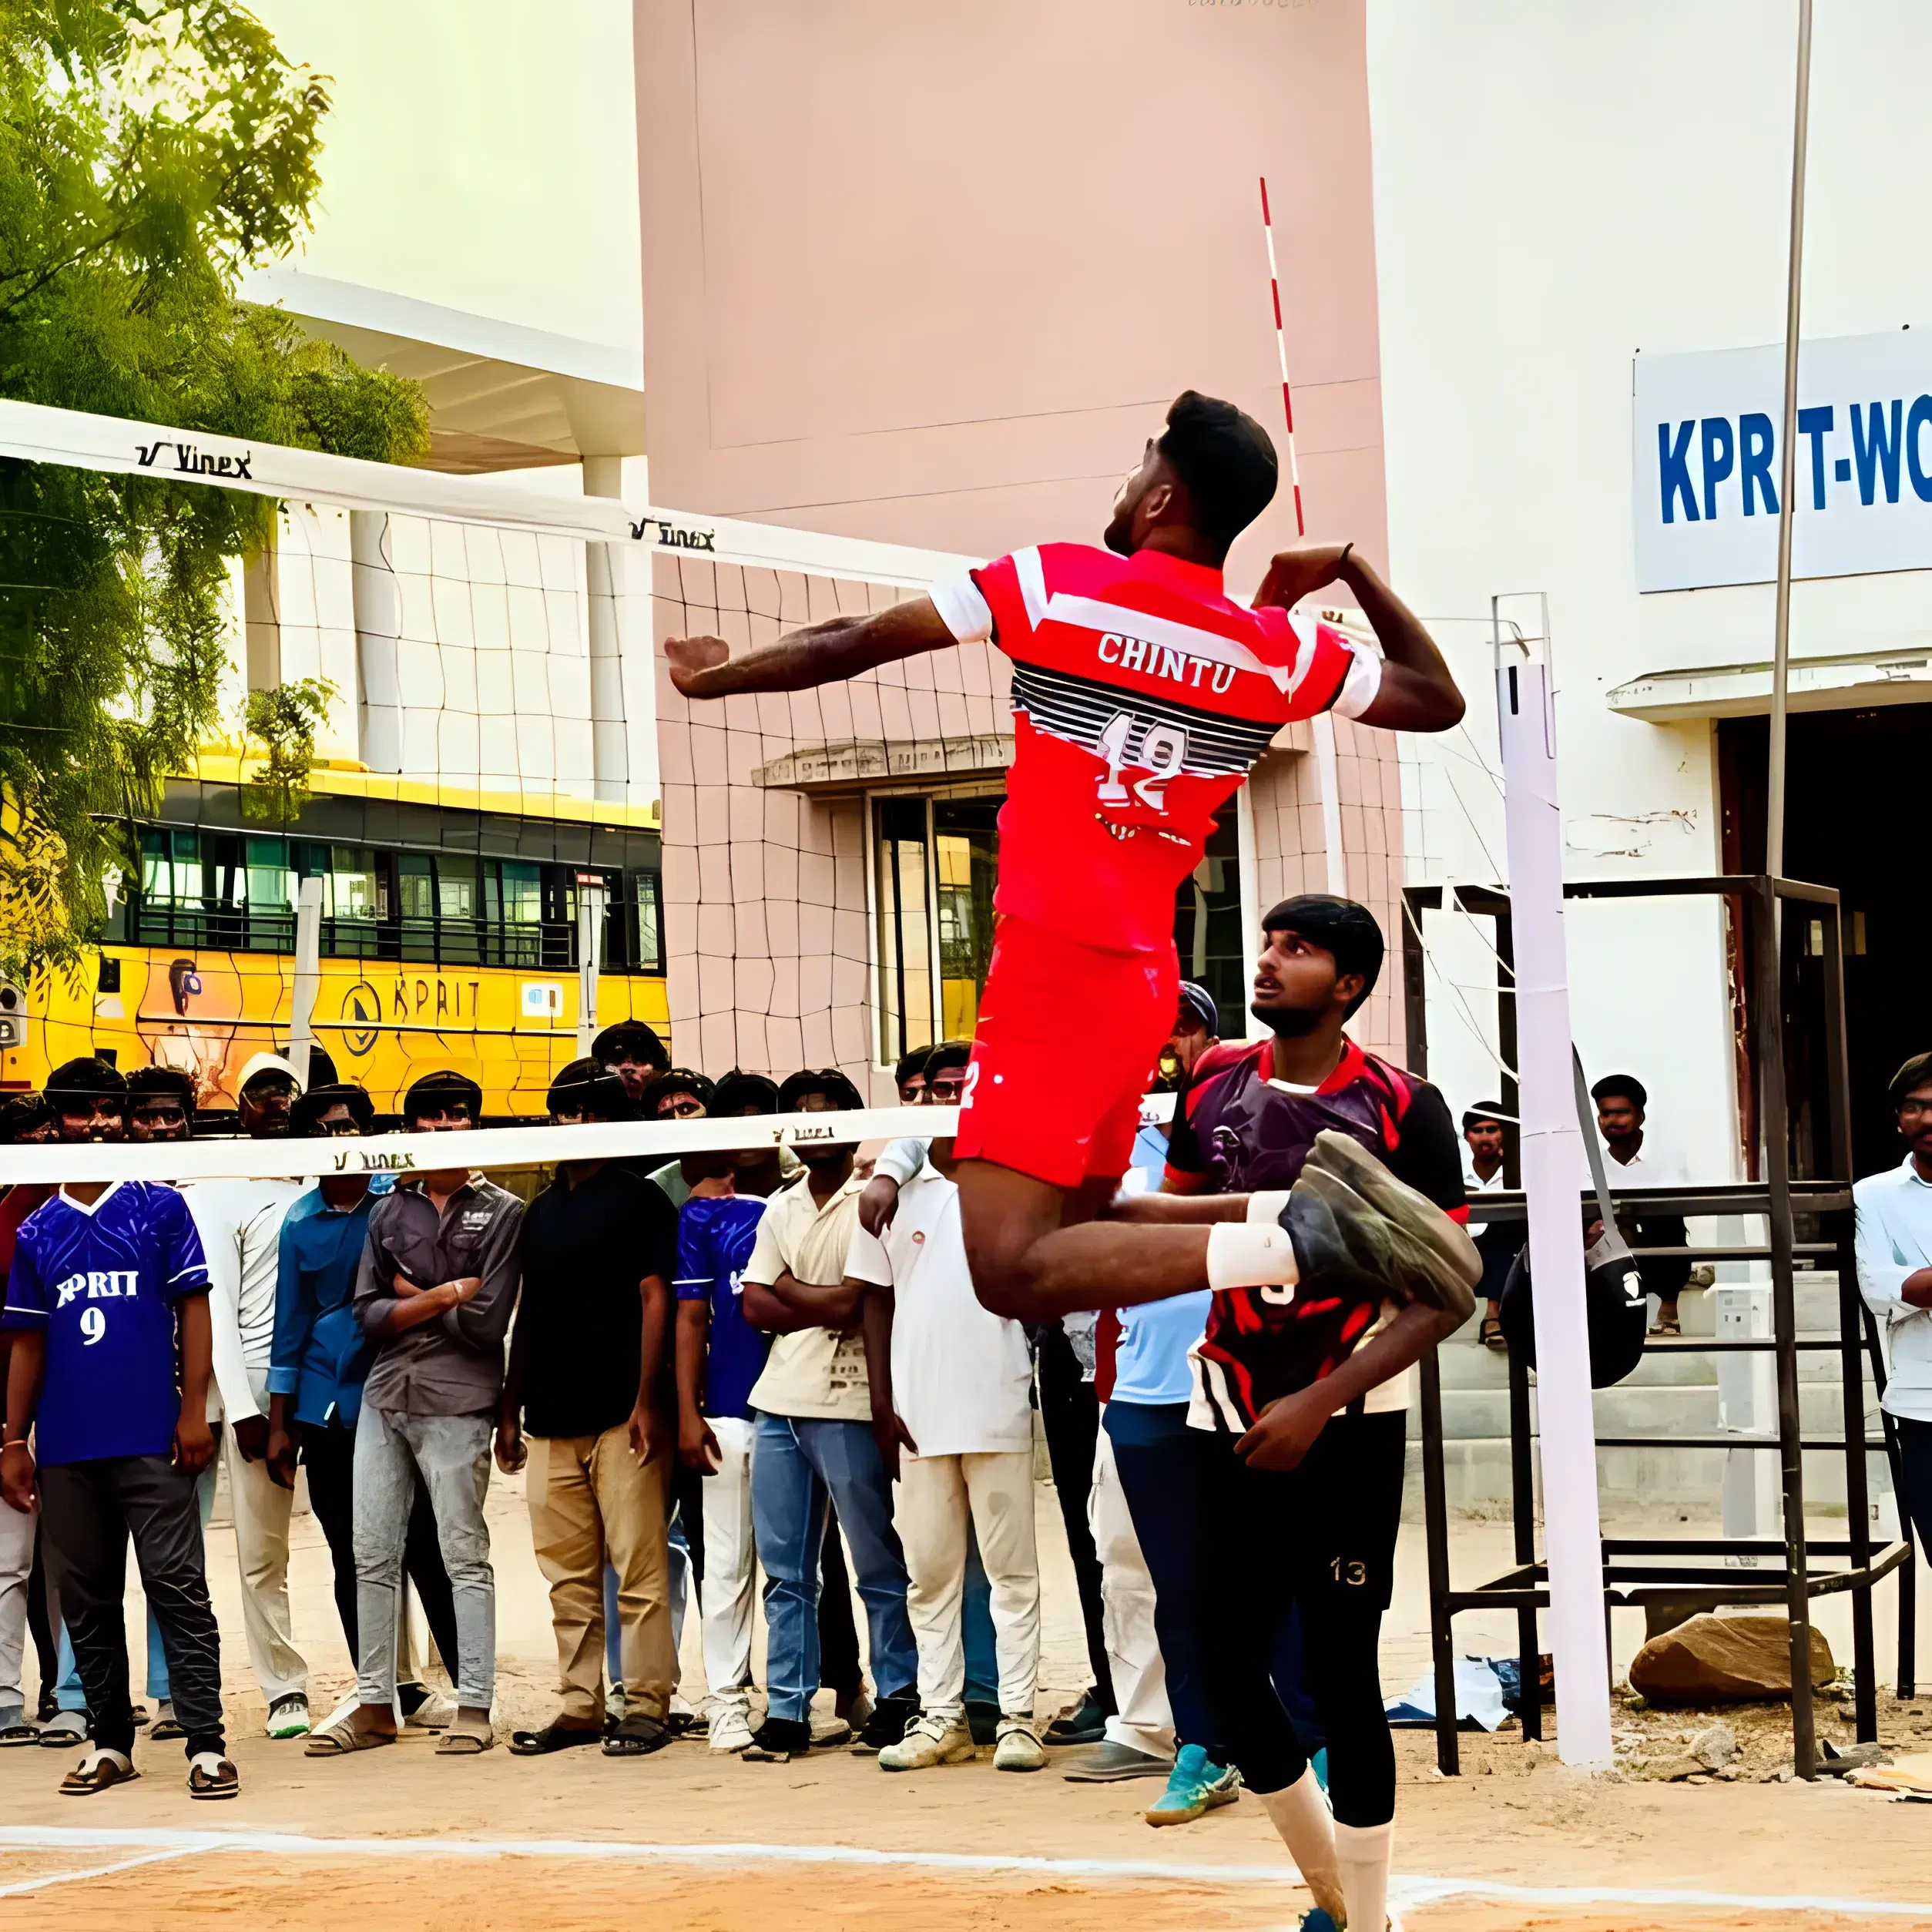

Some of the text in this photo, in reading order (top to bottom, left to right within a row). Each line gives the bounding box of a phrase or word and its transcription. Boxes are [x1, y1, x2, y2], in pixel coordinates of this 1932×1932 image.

[173, 444, 253, 479] Vinex
[1658, 394, 1932, 523] KPRT-WO
[1098, 633, 1236, 693] CHINTU
[80, 1307, 106, 1346] 9
[1330, 1557, 1365, 1585] 13
